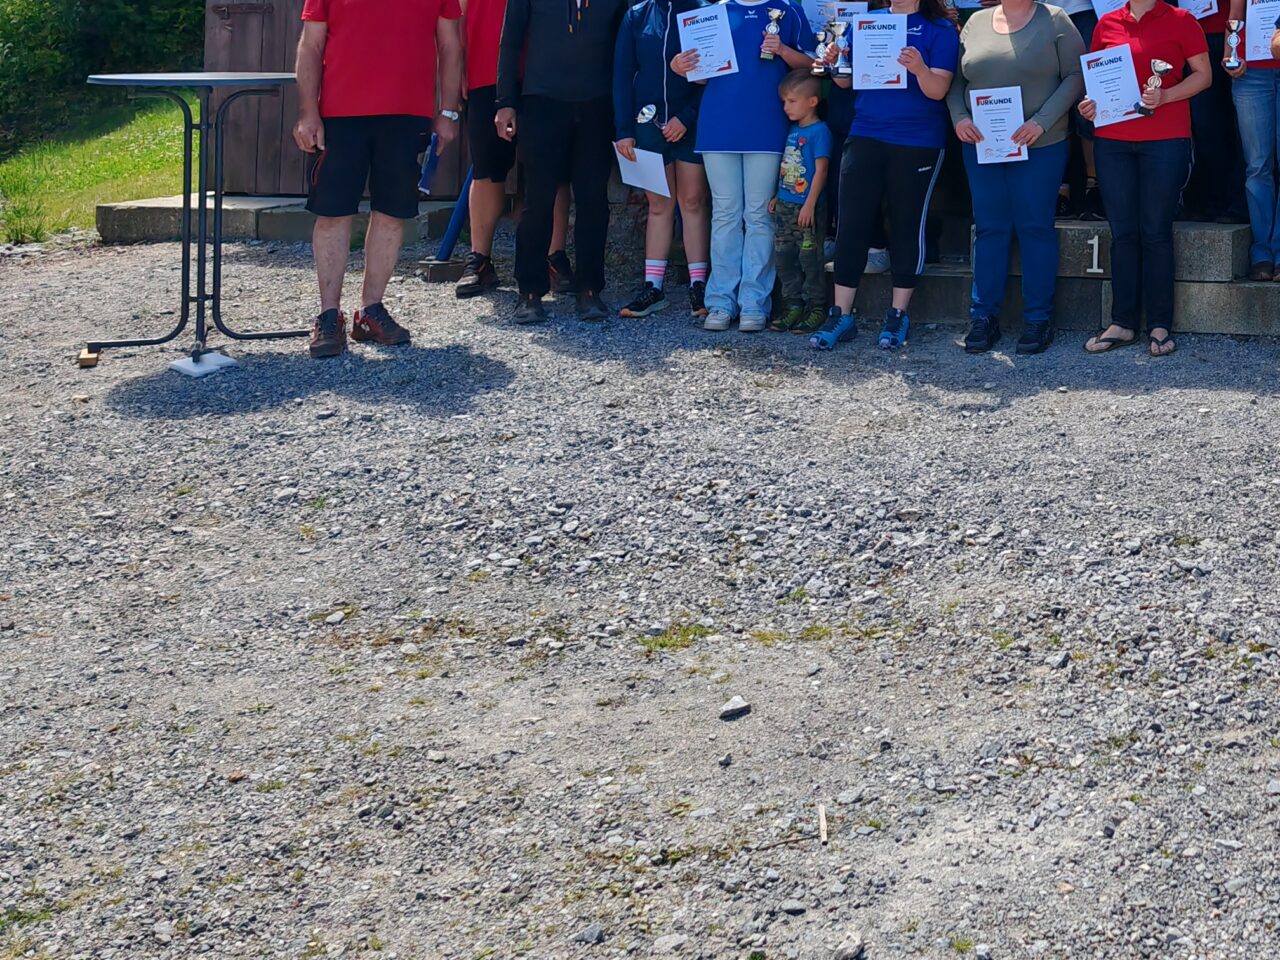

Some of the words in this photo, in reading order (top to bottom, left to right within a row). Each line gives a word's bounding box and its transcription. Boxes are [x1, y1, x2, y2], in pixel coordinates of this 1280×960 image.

[687, 14, 719, 27] URKUNDE
[862, 23, 897, 31] URKUNDE
[1091, 55, 1123, 69] URKUNDE
[981, 97, 1013, 106] URKUNDE
[1086, 235, 1104, 274] 1
